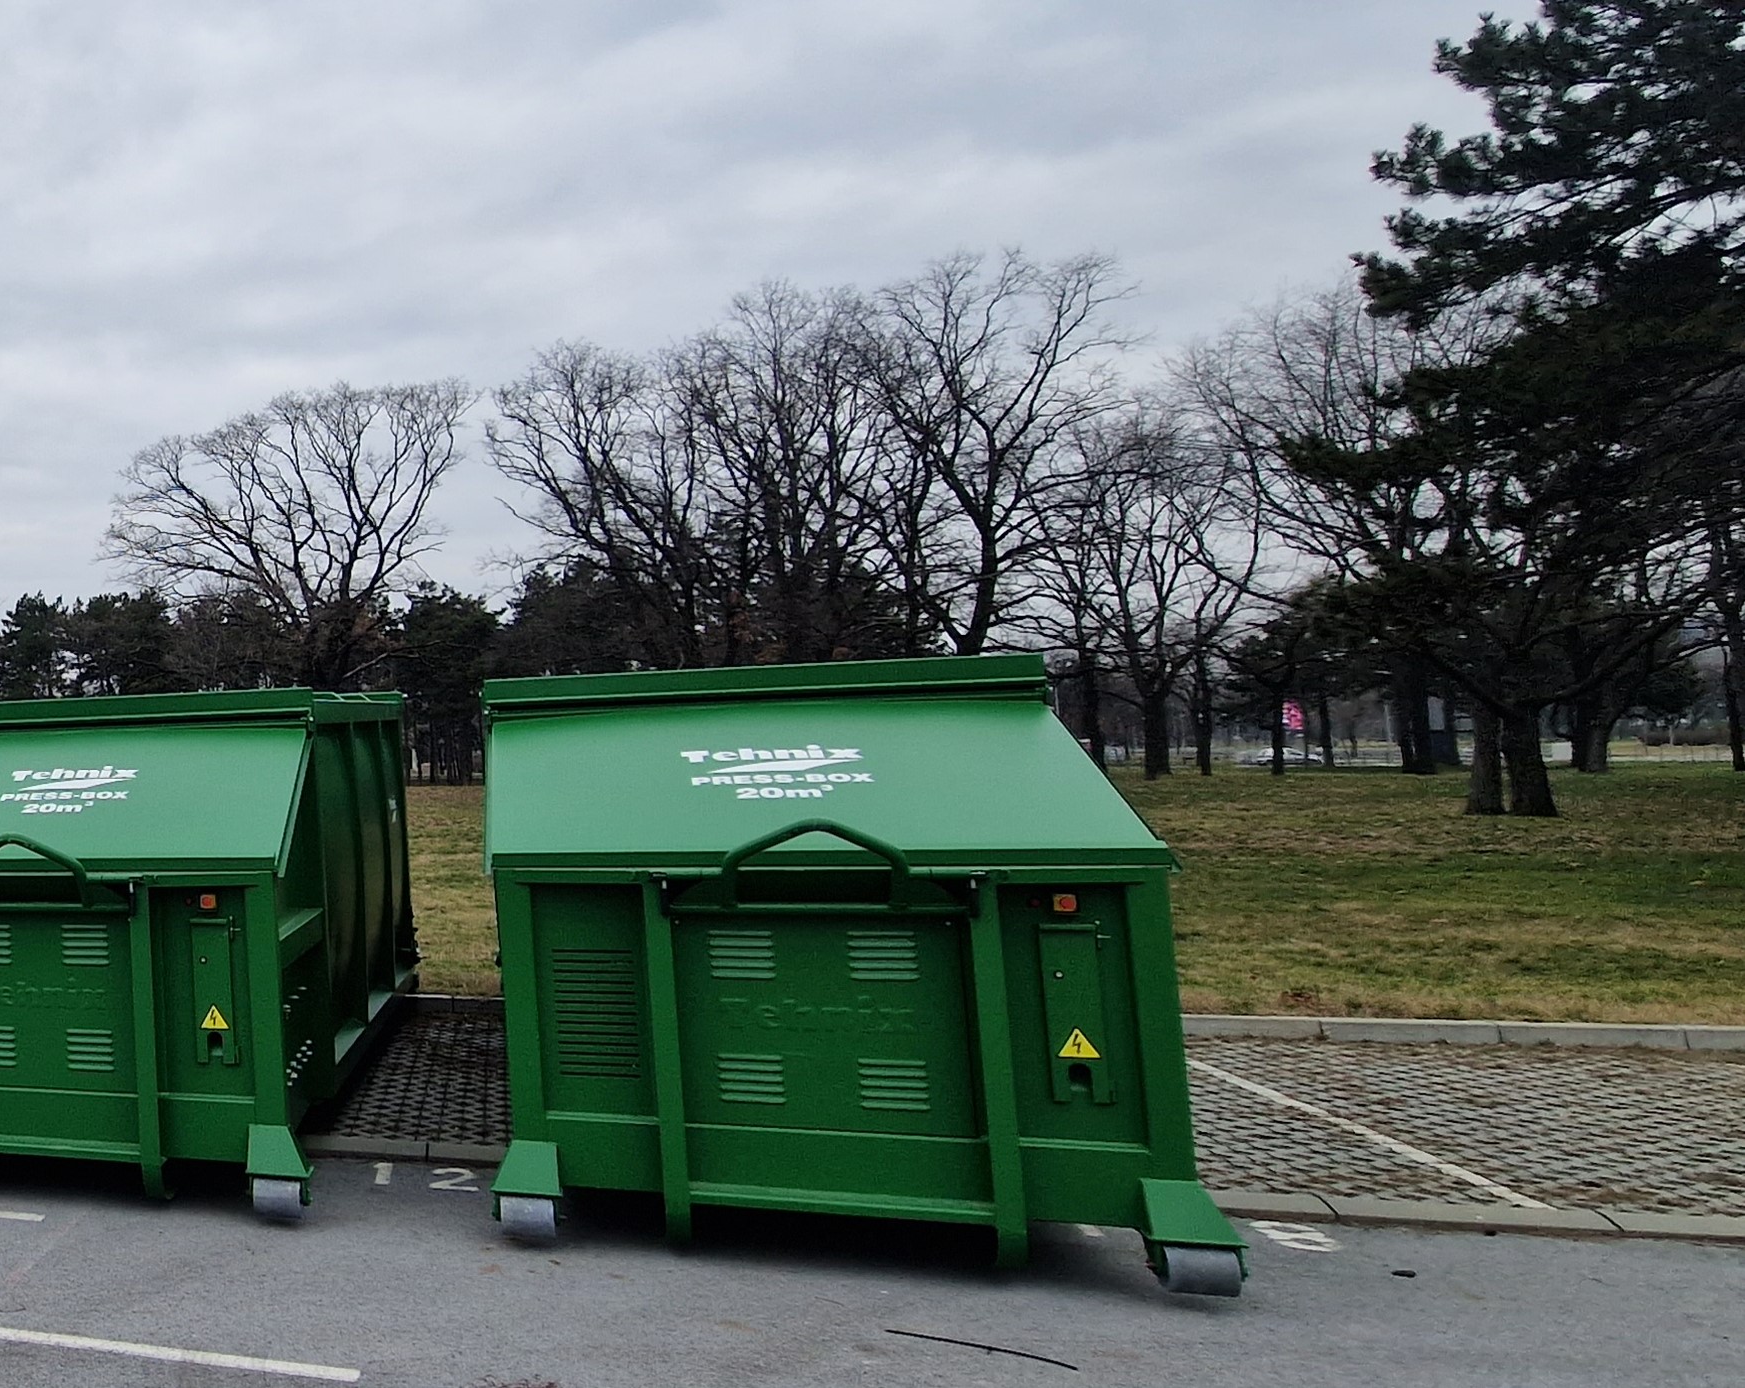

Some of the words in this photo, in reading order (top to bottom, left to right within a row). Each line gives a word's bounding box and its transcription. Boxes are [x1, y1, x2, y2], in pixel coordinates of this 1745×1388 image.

[680, 744, 865, 763] Tehnix
[11, 765, 139, 782] Tehnix
[691, 773, 875, 786] PRESS-BOX
[0, 790, 130, 802] PRESS-BOX
[719, 996, 915, 1033] Tehnix
